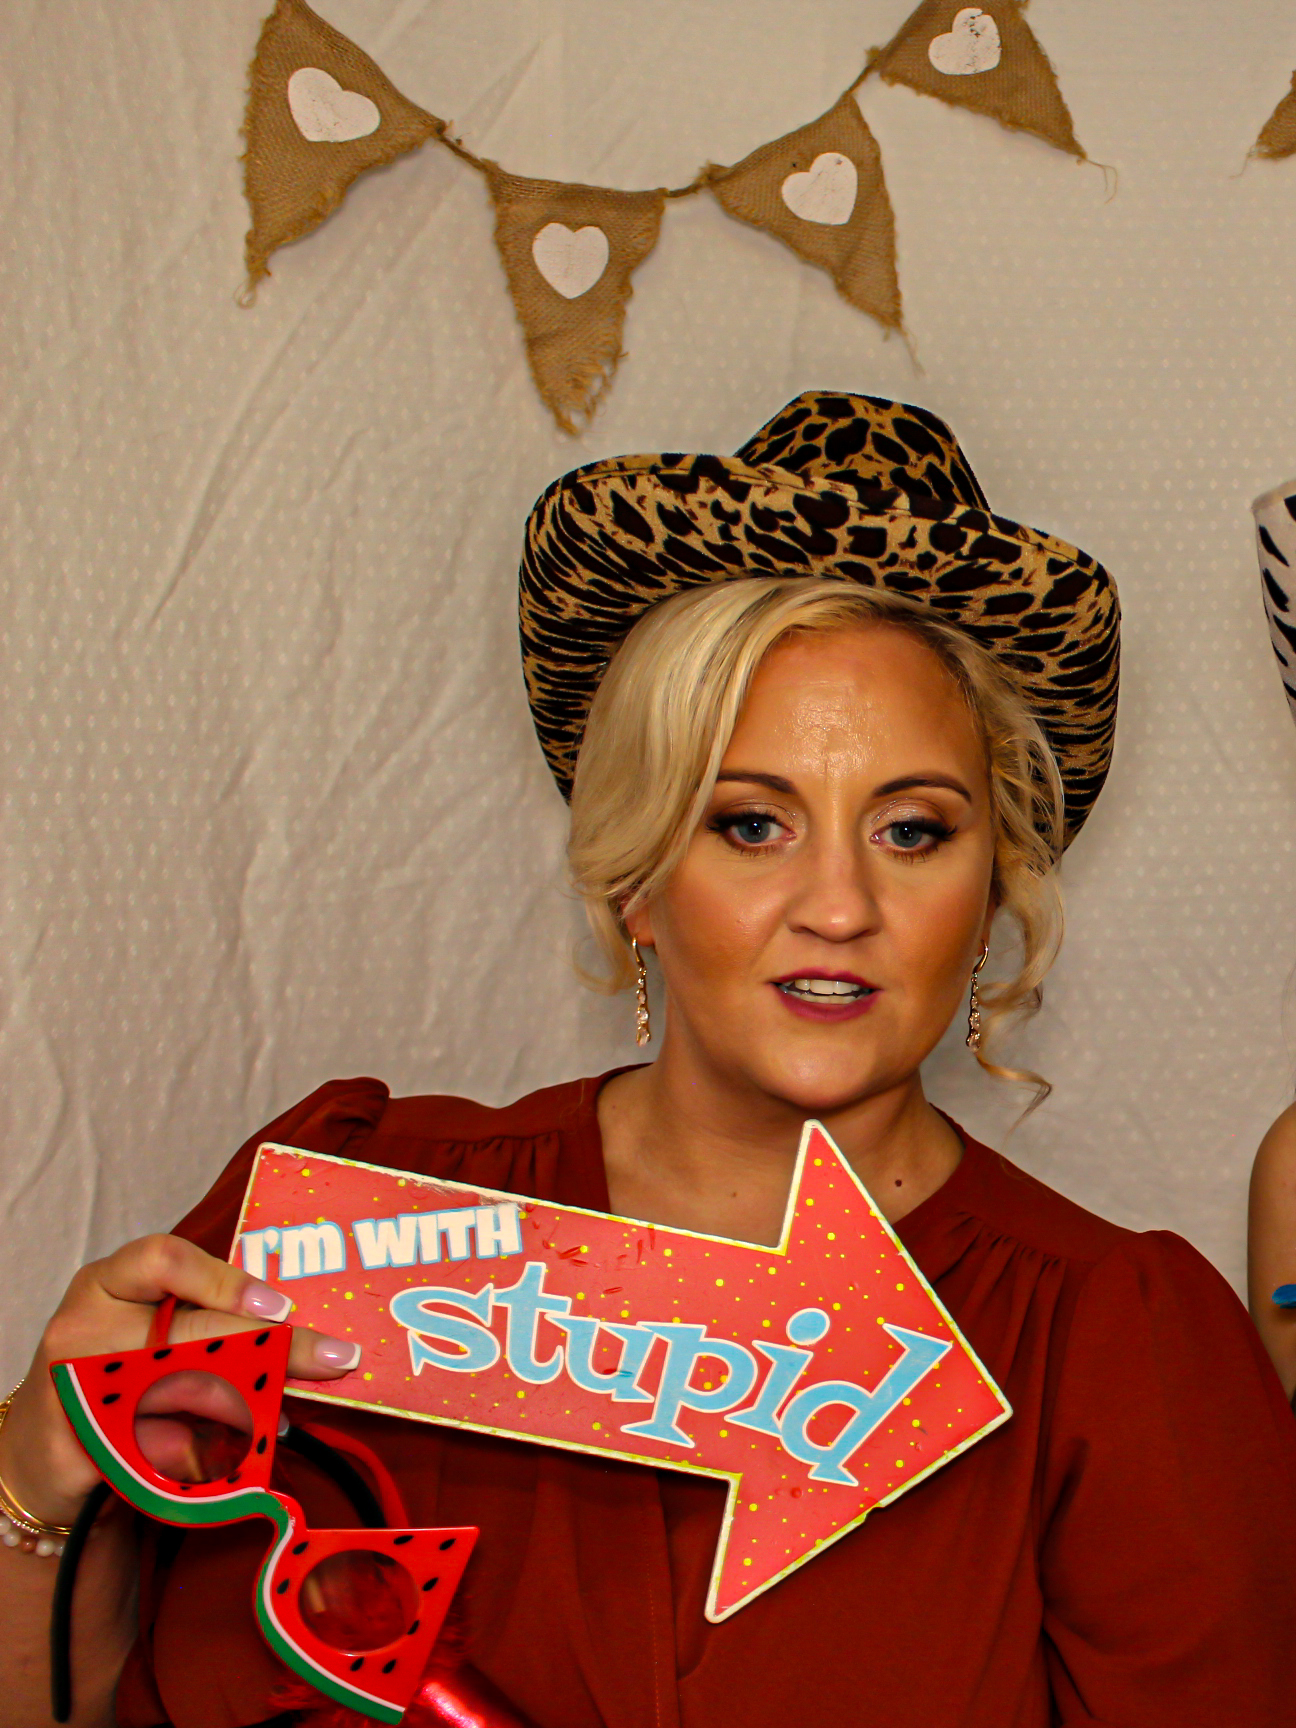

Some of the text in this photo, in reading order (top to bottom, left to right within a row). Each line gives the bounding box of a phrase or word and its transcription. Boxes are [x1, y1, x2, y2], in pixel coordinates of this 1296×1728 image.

[243, 1203, 523, 1279] I'm WITH
[391, 1262, 952, 1485] stupid
